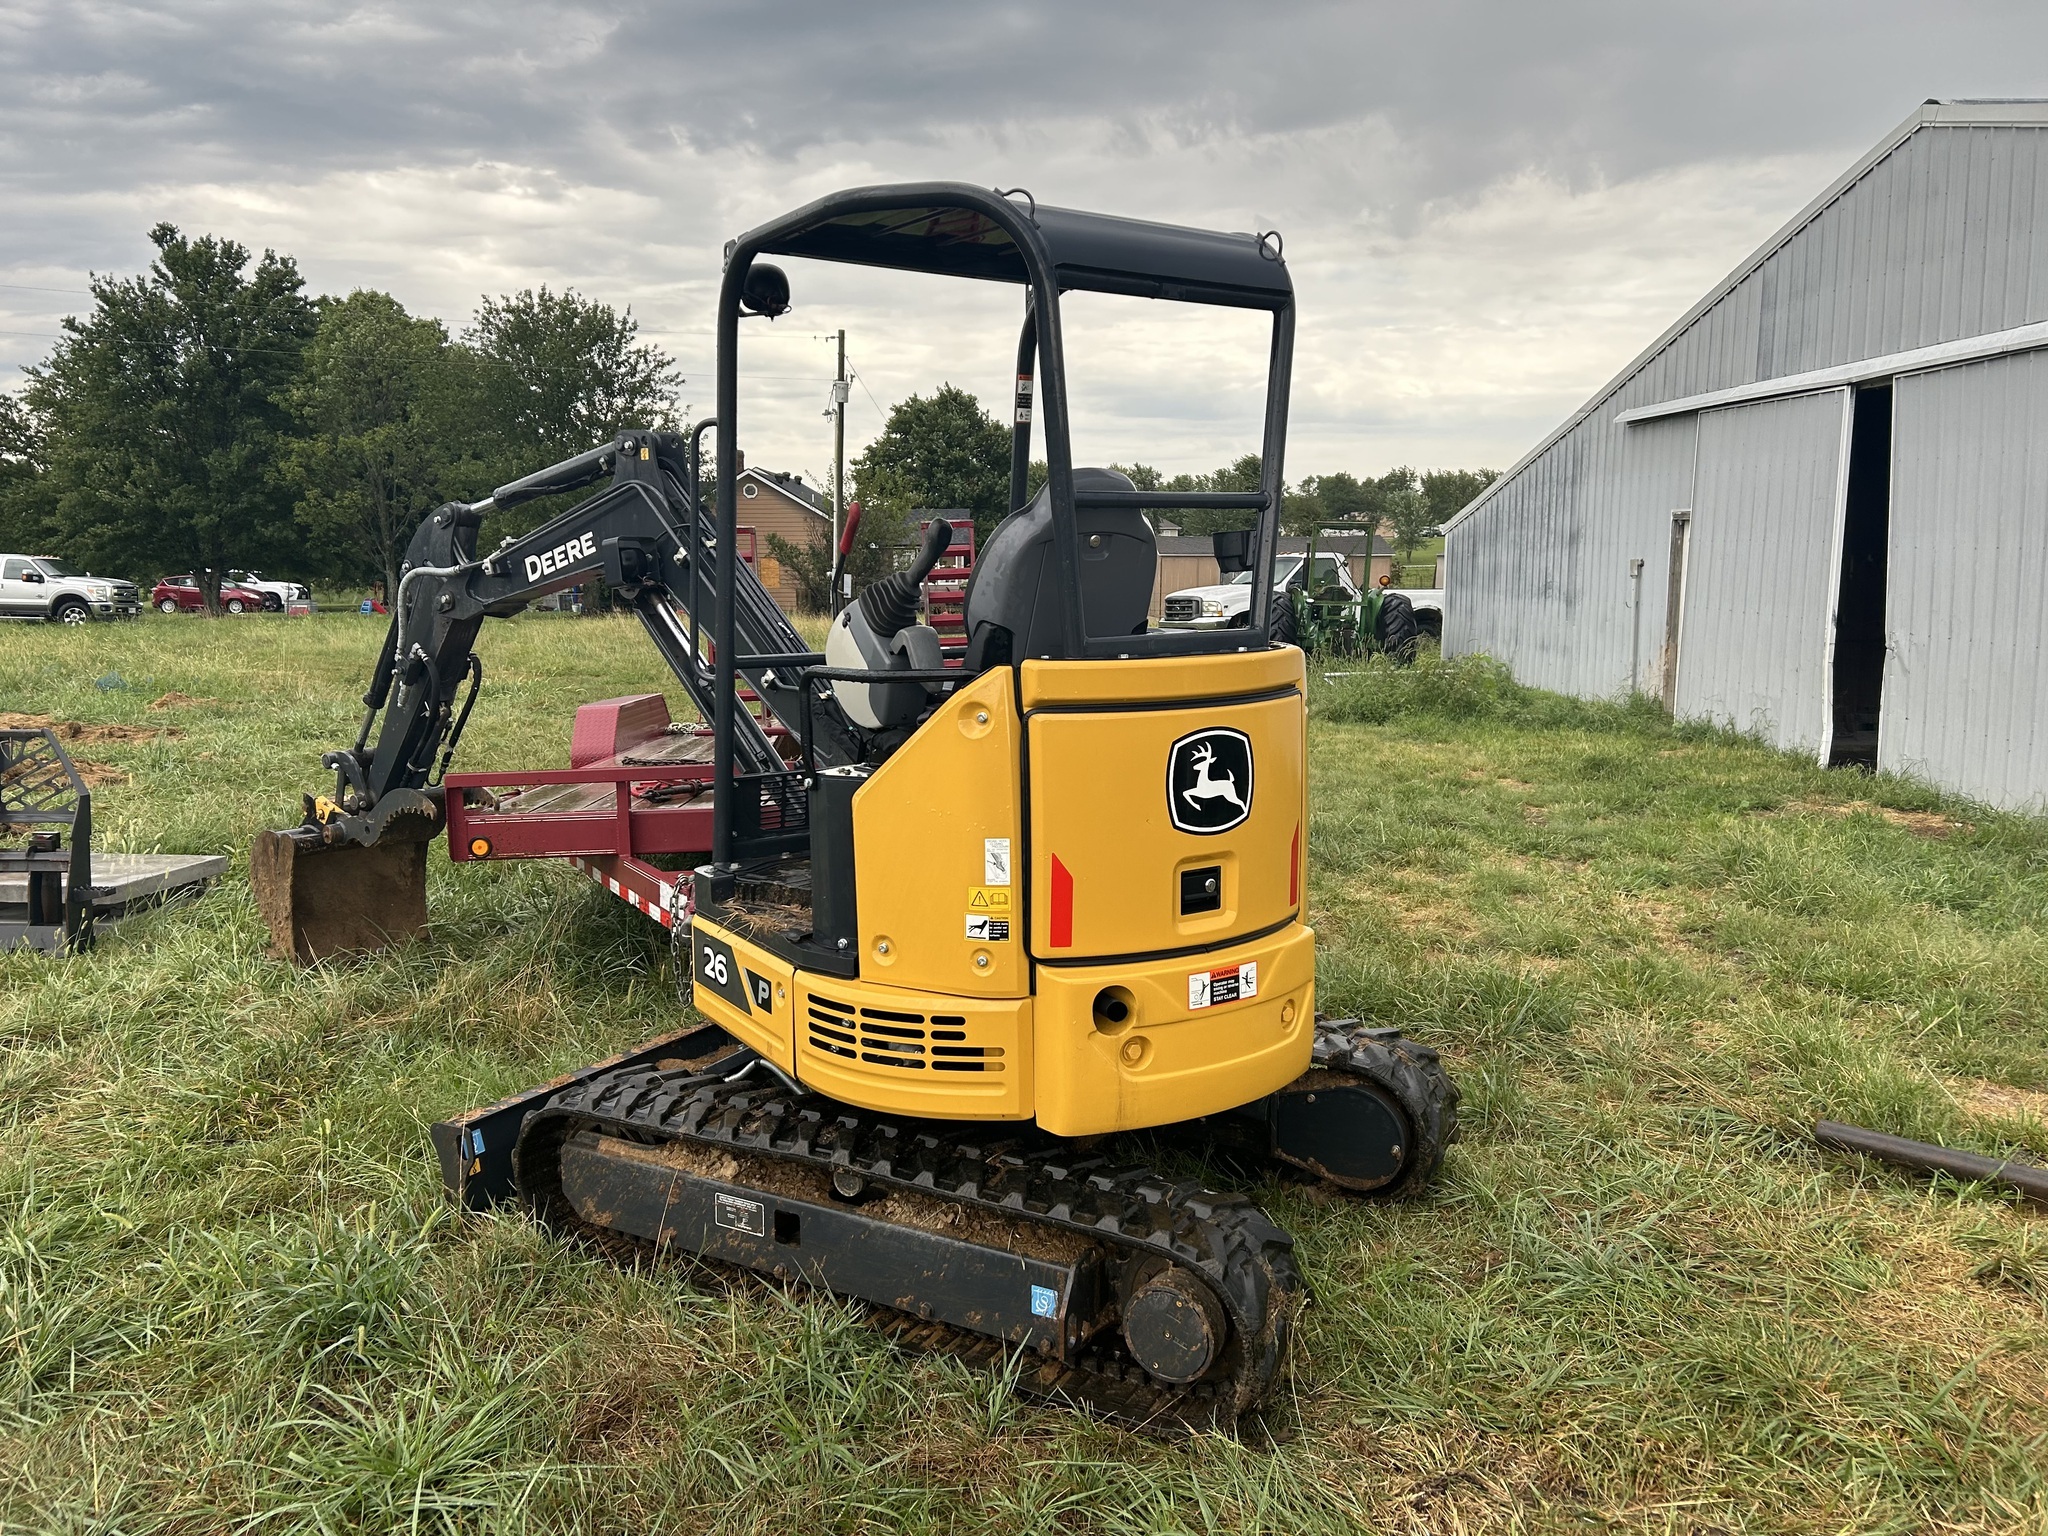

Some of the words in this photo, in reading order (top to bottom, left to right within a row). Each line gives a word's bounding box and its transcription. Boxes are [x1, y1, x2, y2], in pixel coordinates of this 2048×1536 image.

[524, 531, 597, 583] DEERE
[703, 946, 728, 985] 26
[758, 980, 770, 1004] P
[1216, 967, 1239, 977] WARNING
[1223, 992, 1237, 1000] CLEAR
